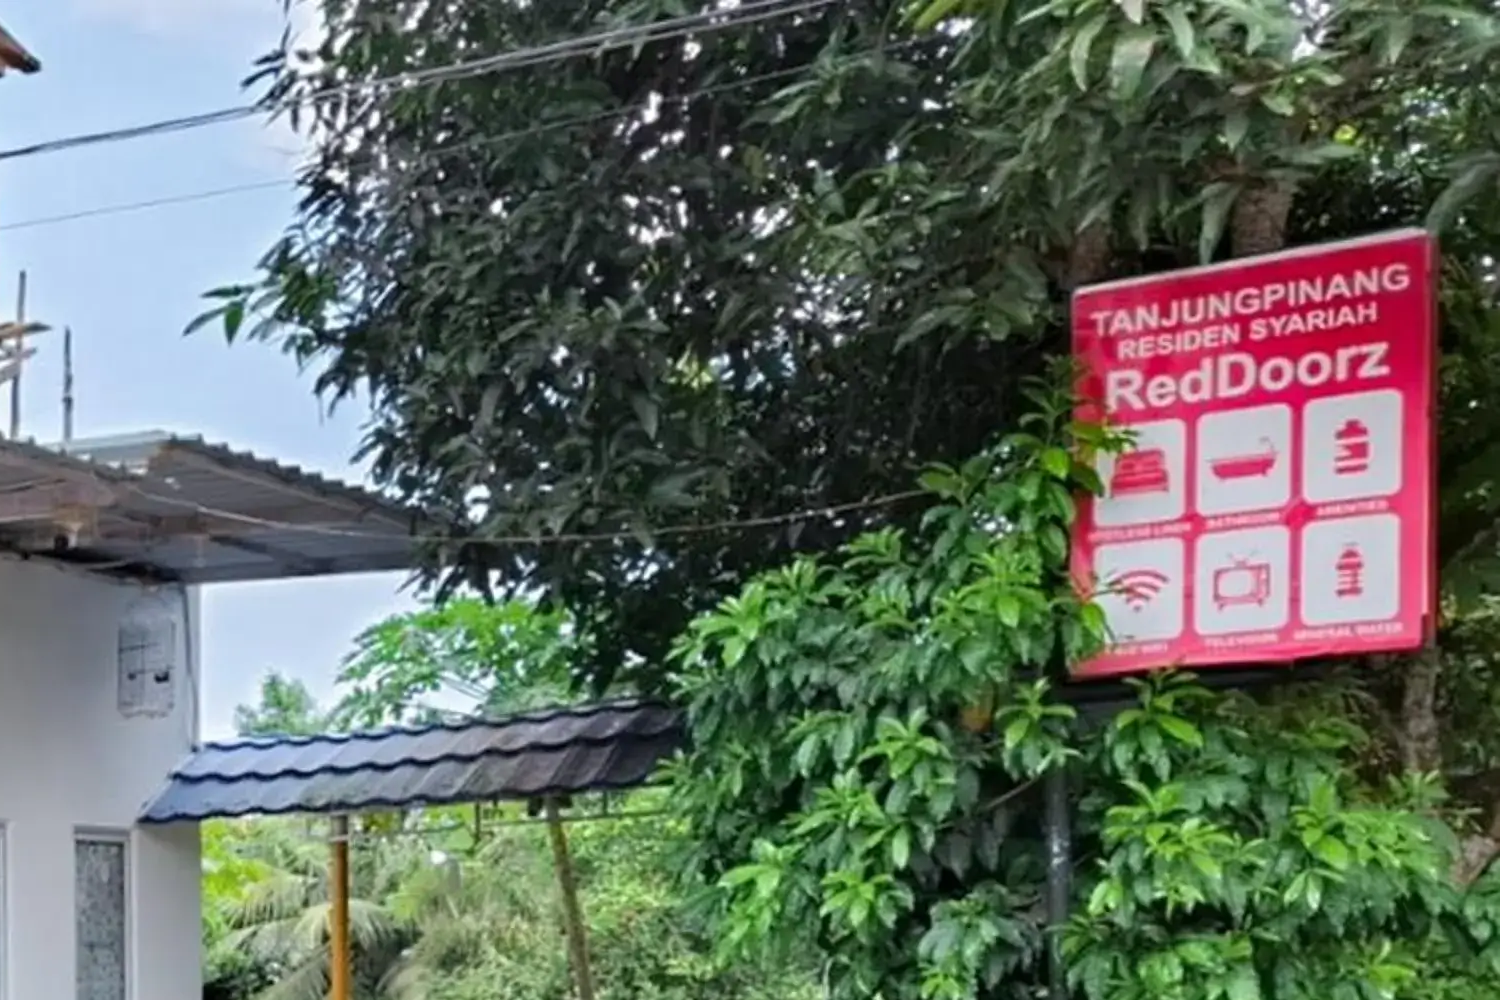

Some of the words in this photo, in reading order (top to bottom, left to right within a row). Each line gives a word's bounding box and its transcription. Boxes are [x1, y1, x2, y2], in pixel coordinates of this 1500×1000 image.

[1090, 263, 1410, 337] TANJUNGPINANG
[1116, 322, 1241, 361] RESIDEN
[1248, 302, 1378, 341] SYARIAH
[1105, 342, 1391, 412] RedDoorz
